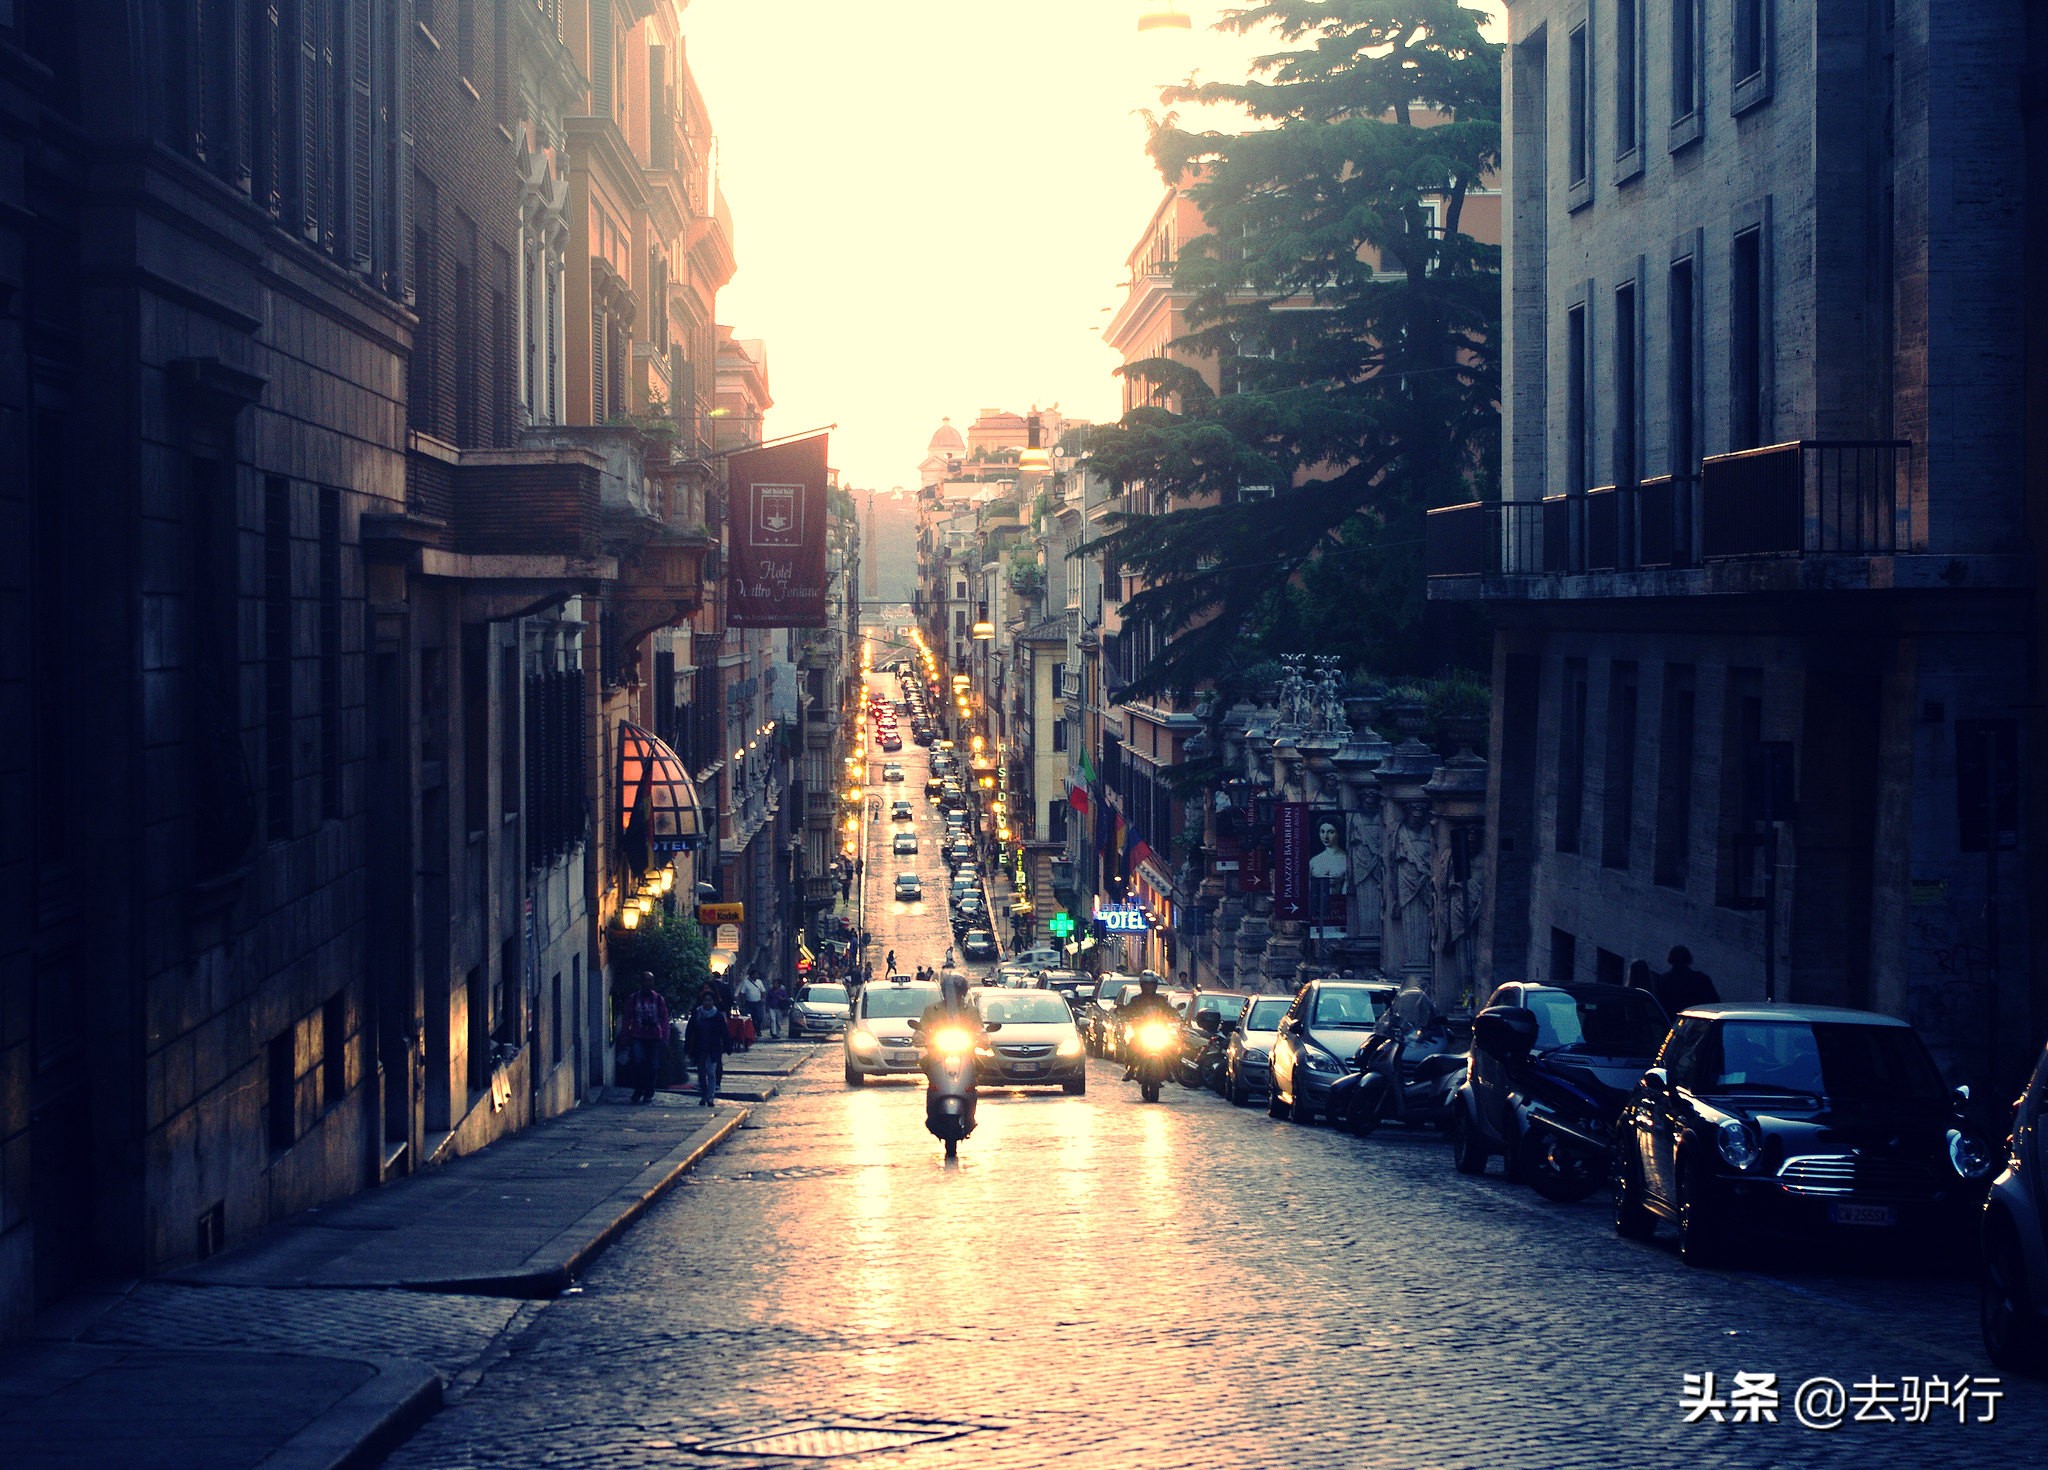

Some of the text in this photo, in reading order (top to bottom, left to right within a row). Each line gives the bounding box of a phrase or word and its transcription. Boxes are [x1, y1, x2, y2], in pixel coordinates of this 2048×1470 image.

[759, 561, 794, 580] Hotel
[736, 578, 771, 599] Quttro
[653, 840, 690, 851] OTEL
[1284, 807, 1292, 898] PALAZZO BARBERINI
[717, 911, 739, 920] Kodak
